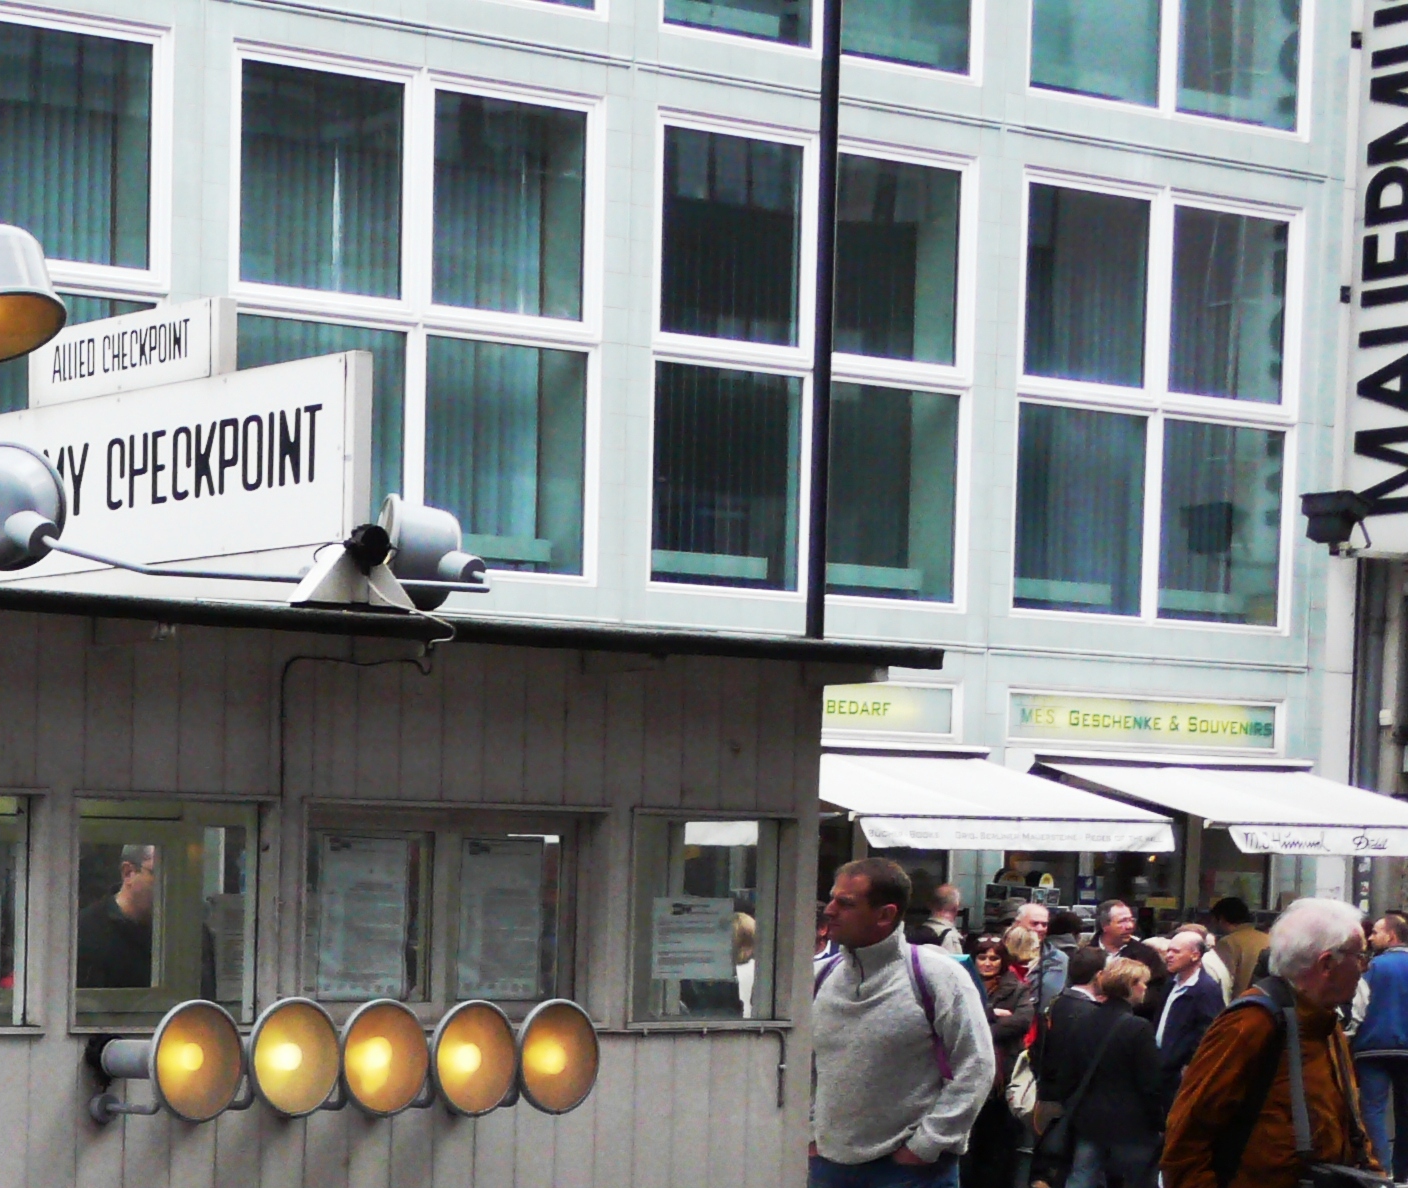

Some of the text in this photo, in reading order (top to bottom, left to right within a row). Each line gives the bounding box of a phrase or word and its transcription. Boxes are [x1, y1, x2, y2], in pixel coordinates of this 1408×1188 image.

[52, 319, 191, 384] ALLIED CHECKPOINT
[106, 403, 323, 511] CHECKPOINT
[826, 699, 892, 716] BEDARF
[1069, 709, 1162, 731] GESCHENKE
[1169, 715, 1180, 731] &
[1187, 716, 1273, 737] SOUVENIRS
